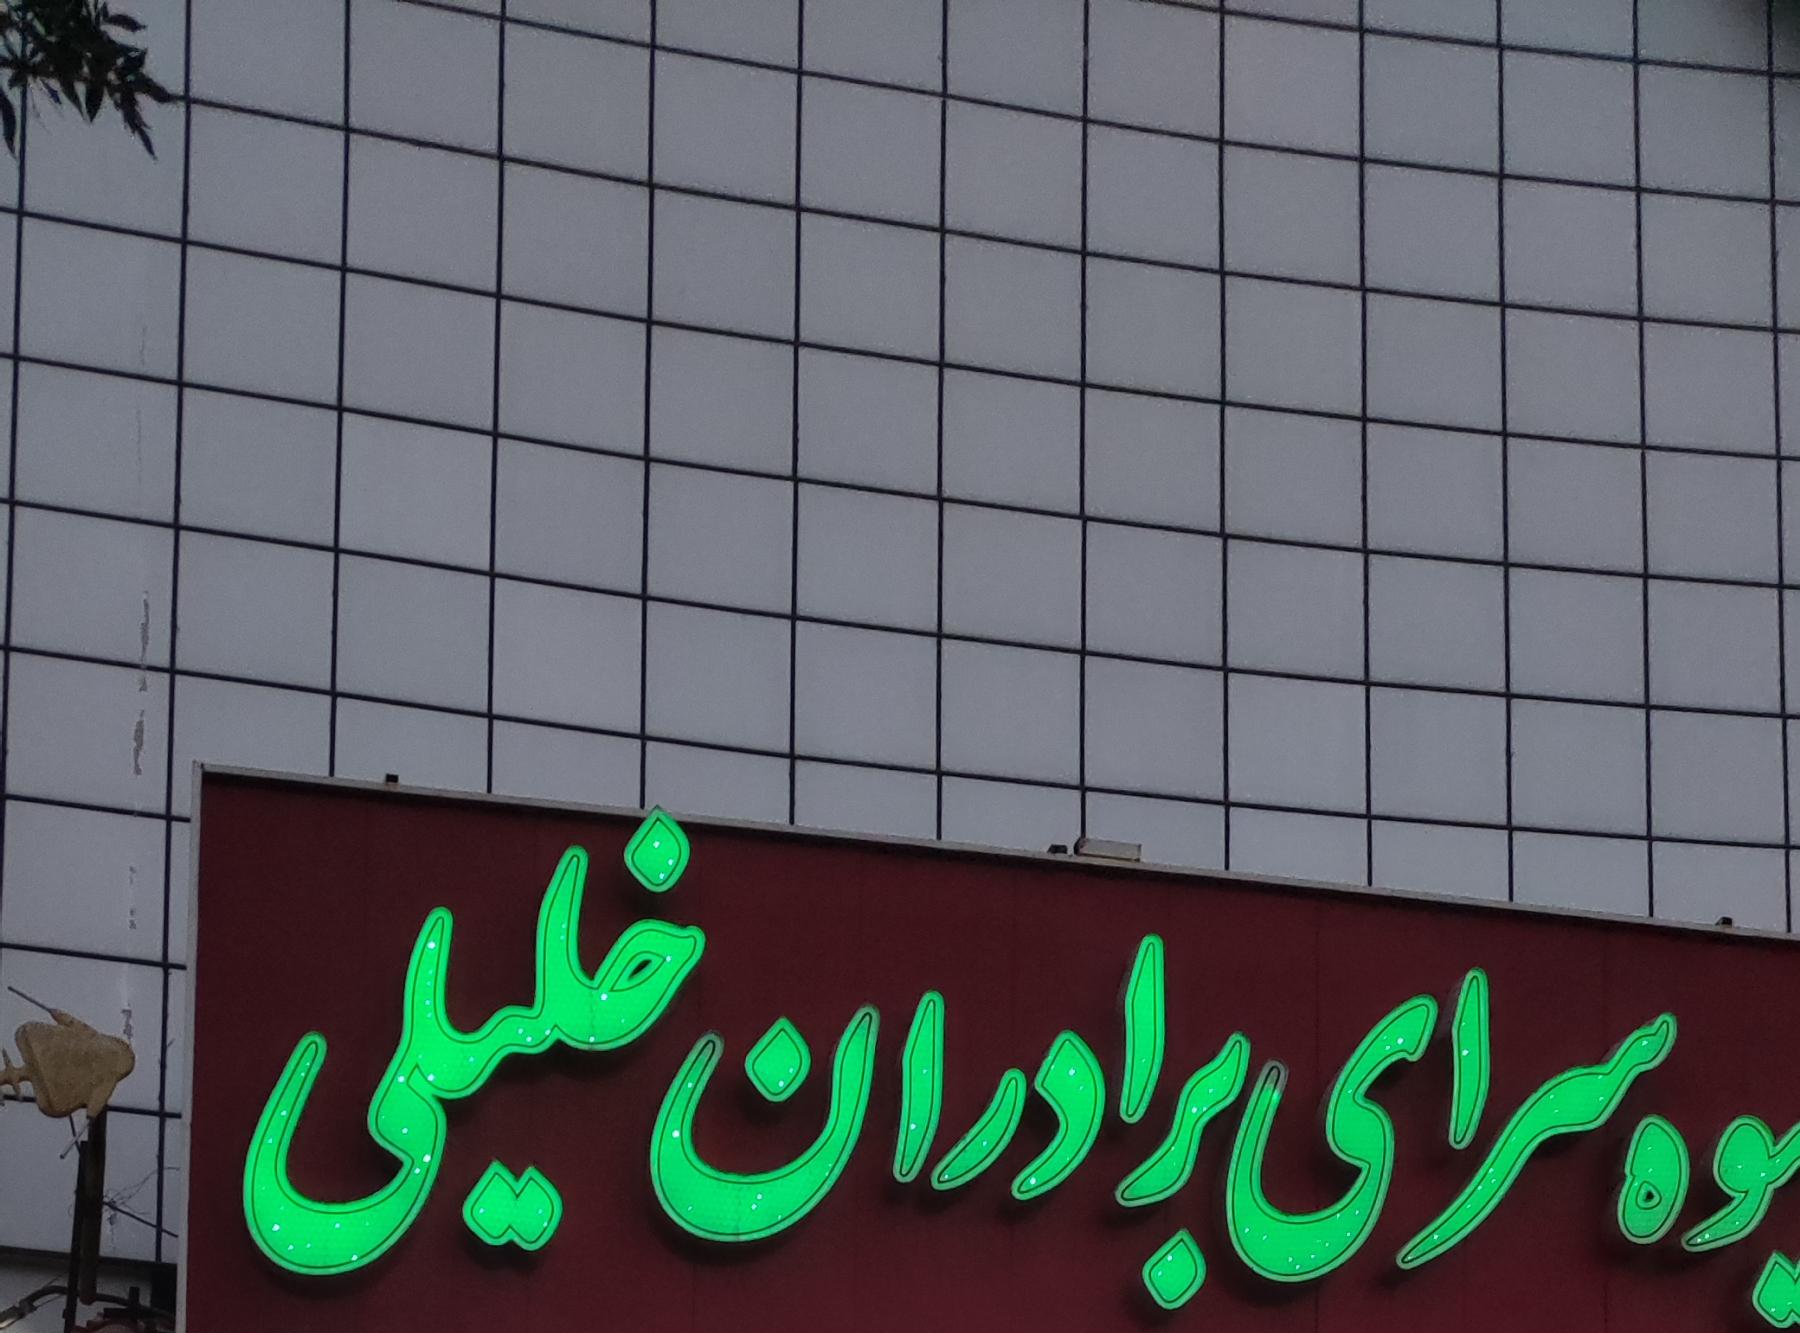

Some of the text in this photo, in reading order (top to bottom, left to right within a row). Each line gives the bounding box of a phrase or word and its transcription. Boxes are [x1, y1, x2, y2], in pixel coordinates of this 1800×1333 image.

[243, 804, 1800, 1329] یوه سرای برادران خلیلی
